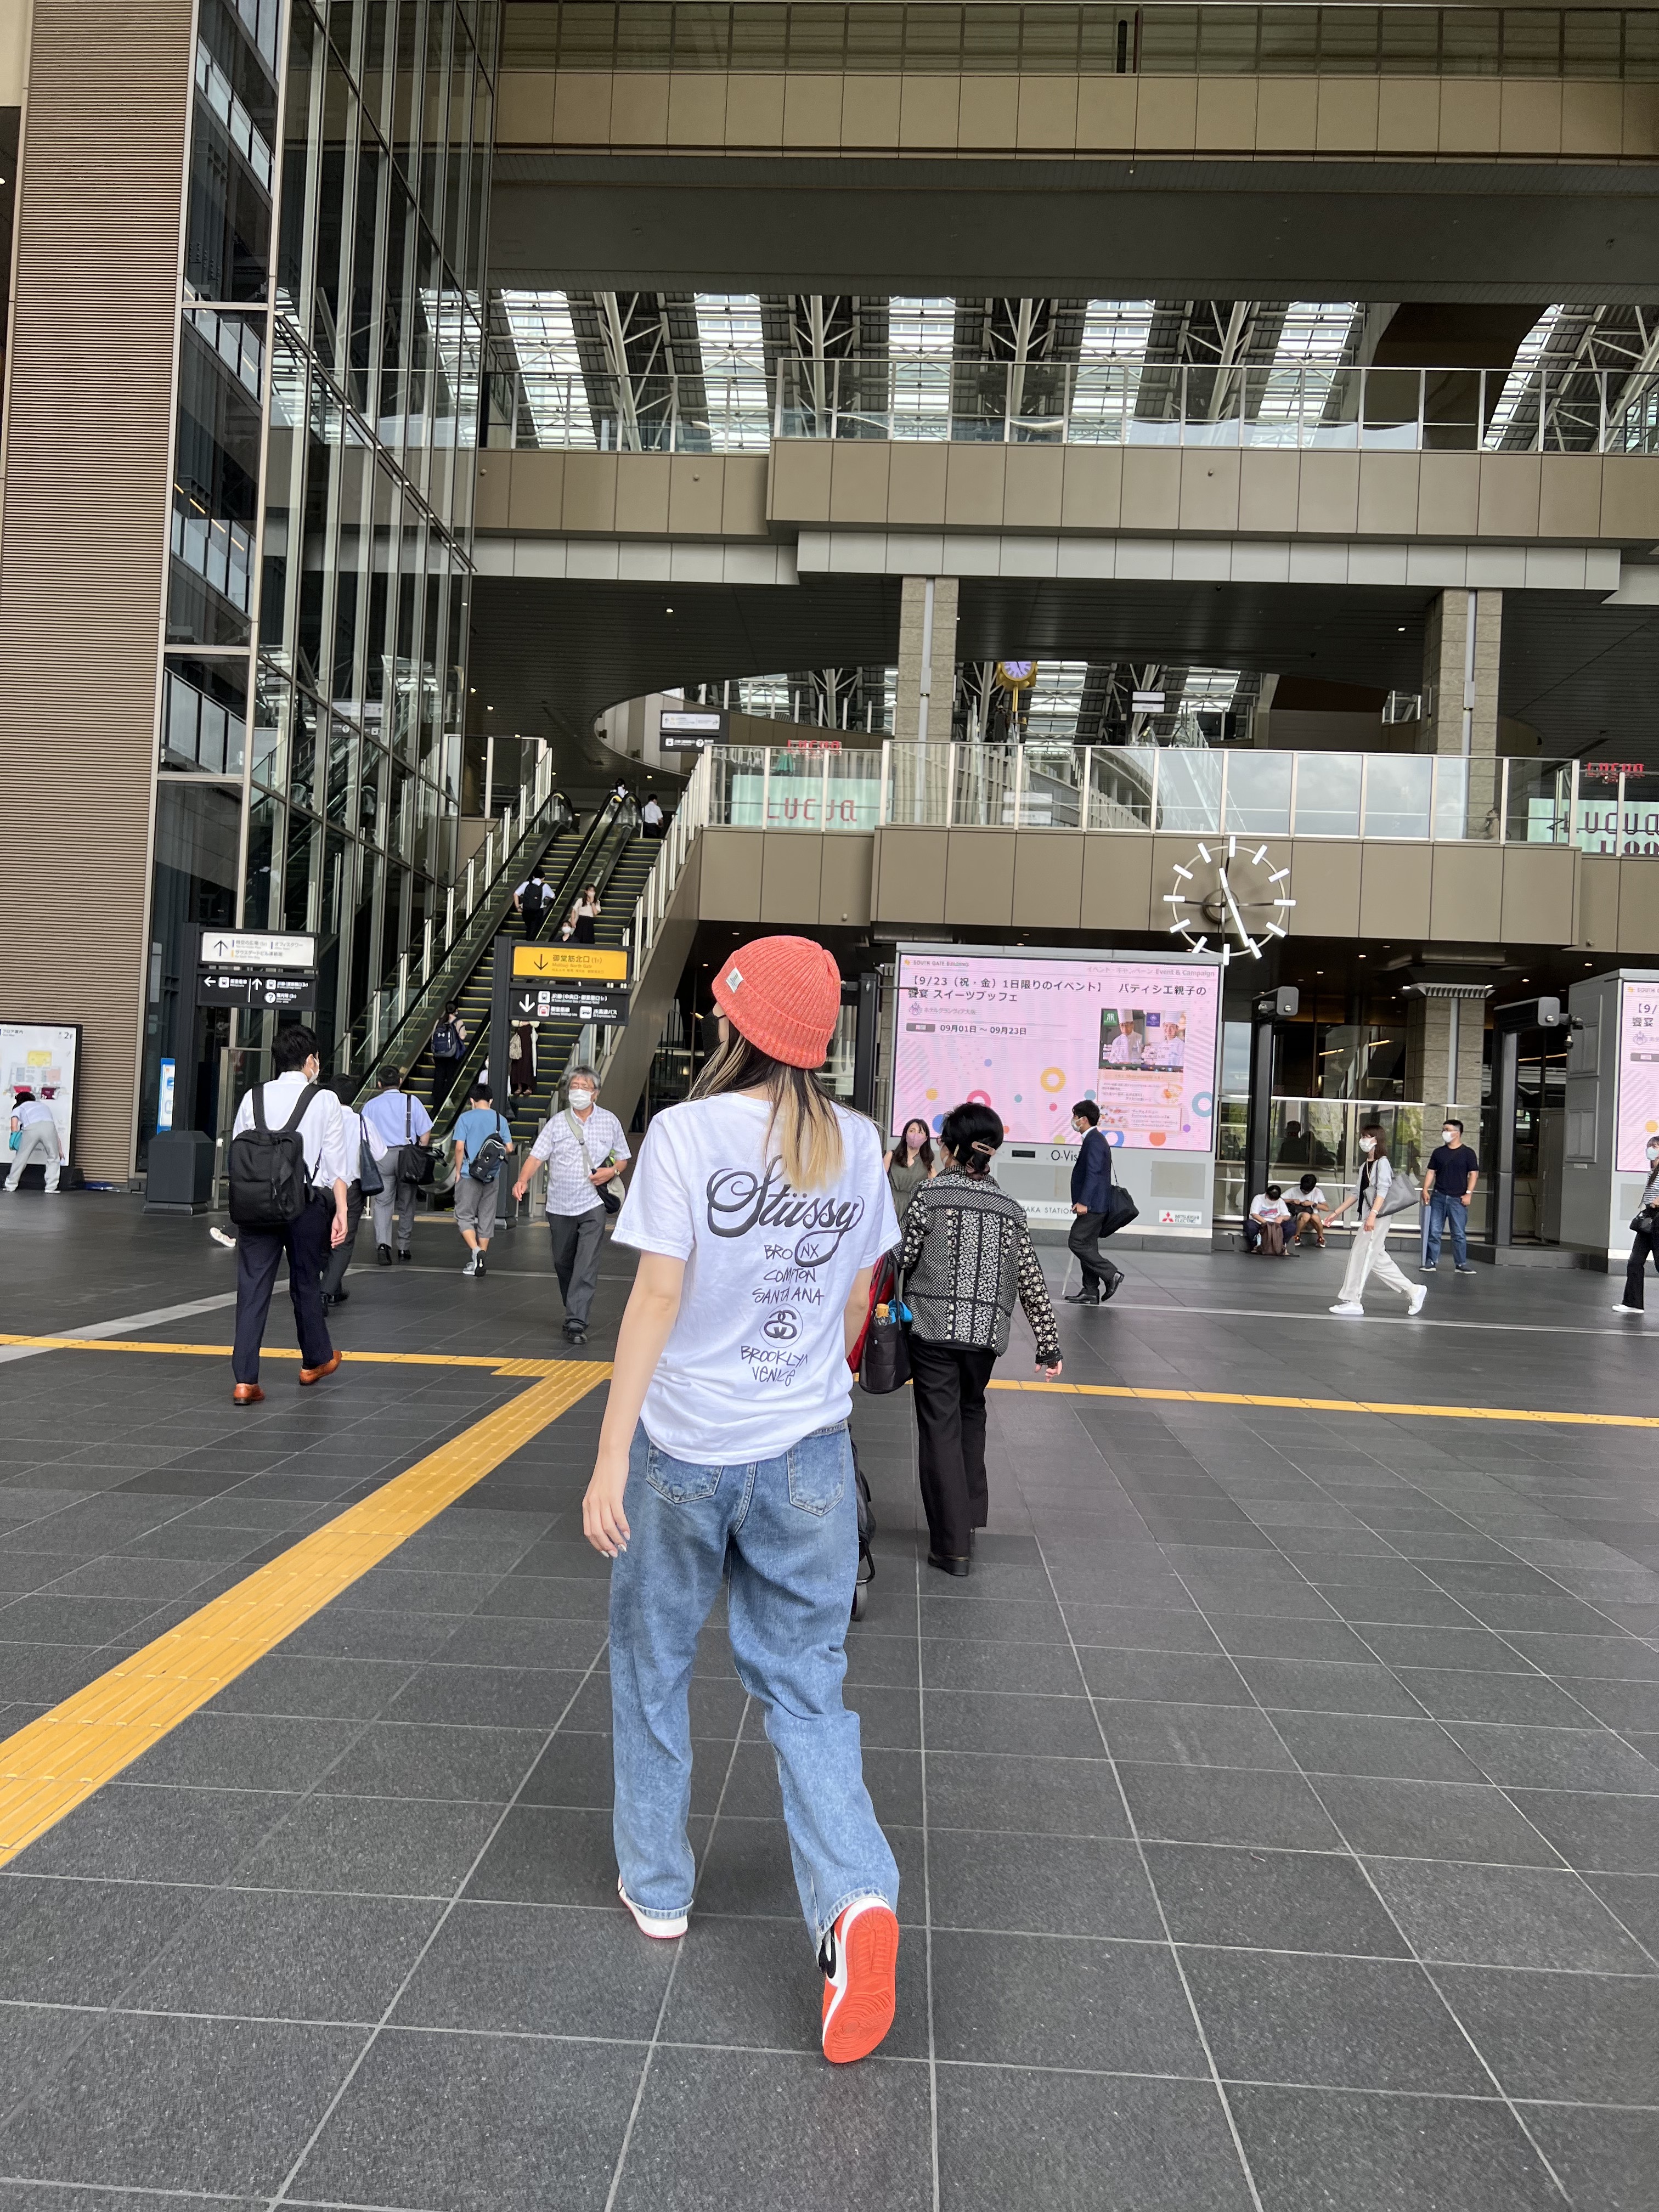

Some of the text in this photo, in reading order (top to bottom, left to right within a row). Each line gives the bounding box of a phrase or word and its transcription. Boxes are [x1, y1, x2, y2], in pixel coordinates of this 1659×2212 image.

[940, 1024, 977, 1033] 09月01日
[990, 1027, 1027, 1035] 09月23日
[1051, 1150, 1080, 1162] O-Vis
[764, 1242, 820, 1260] BRONX
[763, 1267, 816, 1284] COMPTON
[752, 1286, 825, 1306] SANTA ANA
